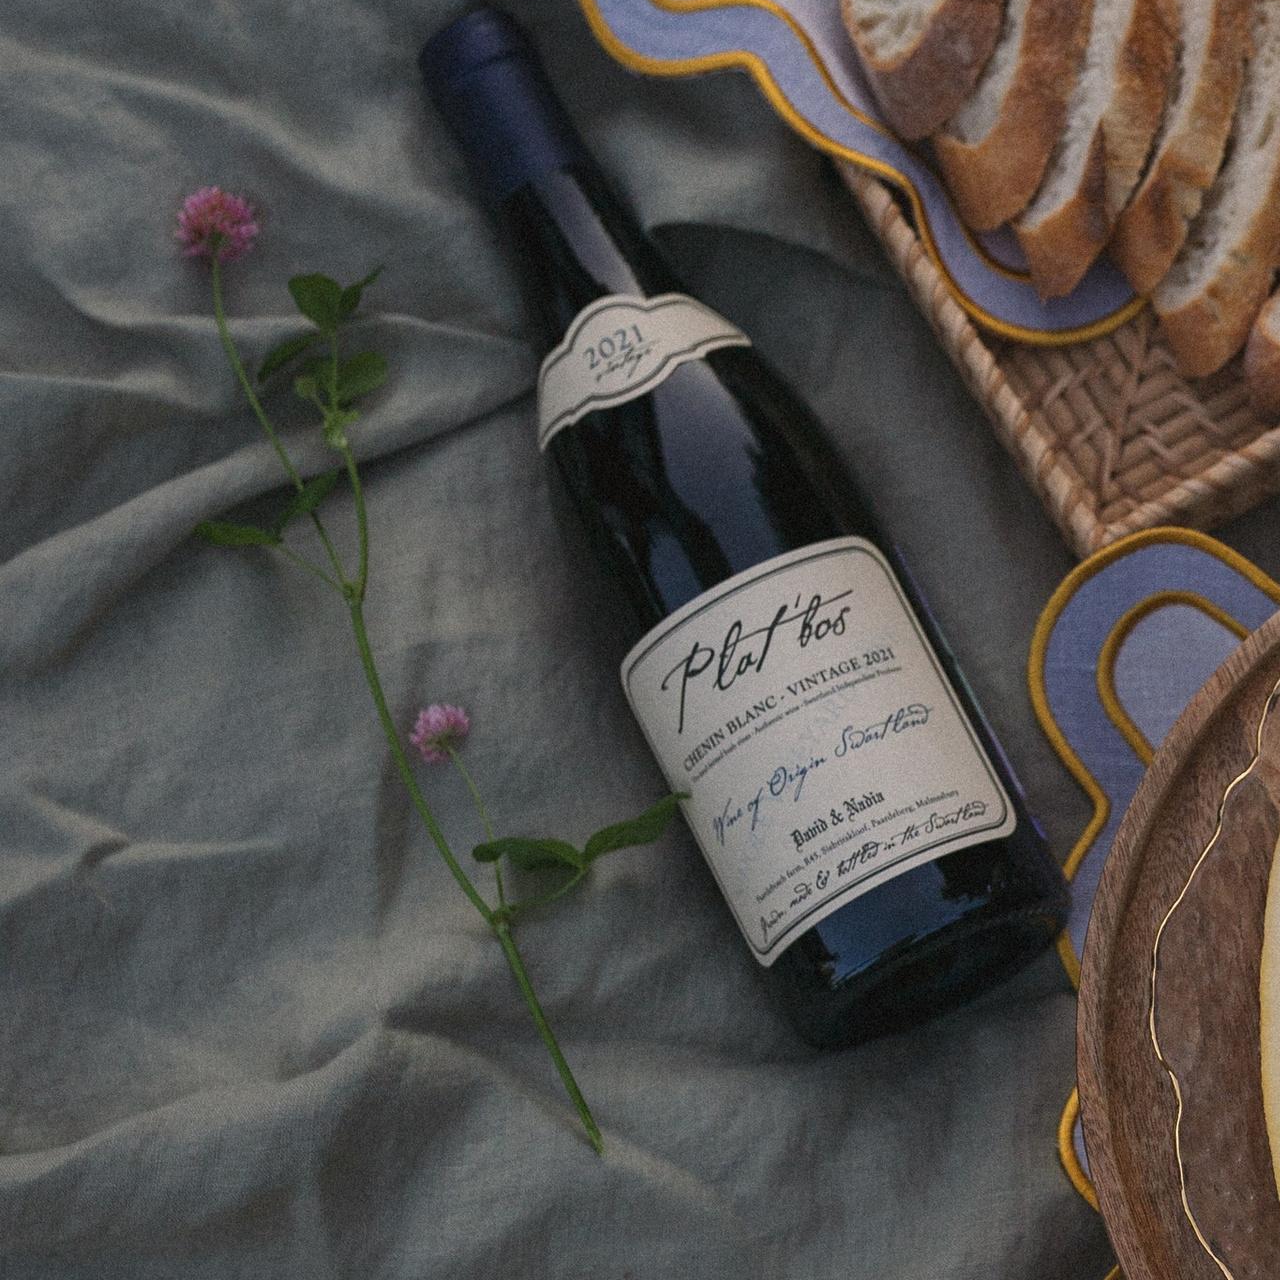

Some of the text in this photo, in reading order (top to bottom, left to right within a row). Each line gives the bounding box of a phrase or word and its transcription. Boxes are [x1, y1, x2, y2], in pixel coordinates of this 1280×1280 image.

[583, 325, 643, 370] 2021
[683, 729, 726, 772] CHENIN
[728, 695, 778, 735] BLANC
[786, 659, 862, 696] VINTAGE
[865, 646, 896, 667] 2021
[712, 703, 933, 846] Wine of Origin Swartland
[790, 790, 885, 853] David & Nadia
[790, 882, 814, 908] made
[837, 841, 882, 878] bottled
[898, 825, 920, 846] the
[925, 800, 989, 834] Swartland
